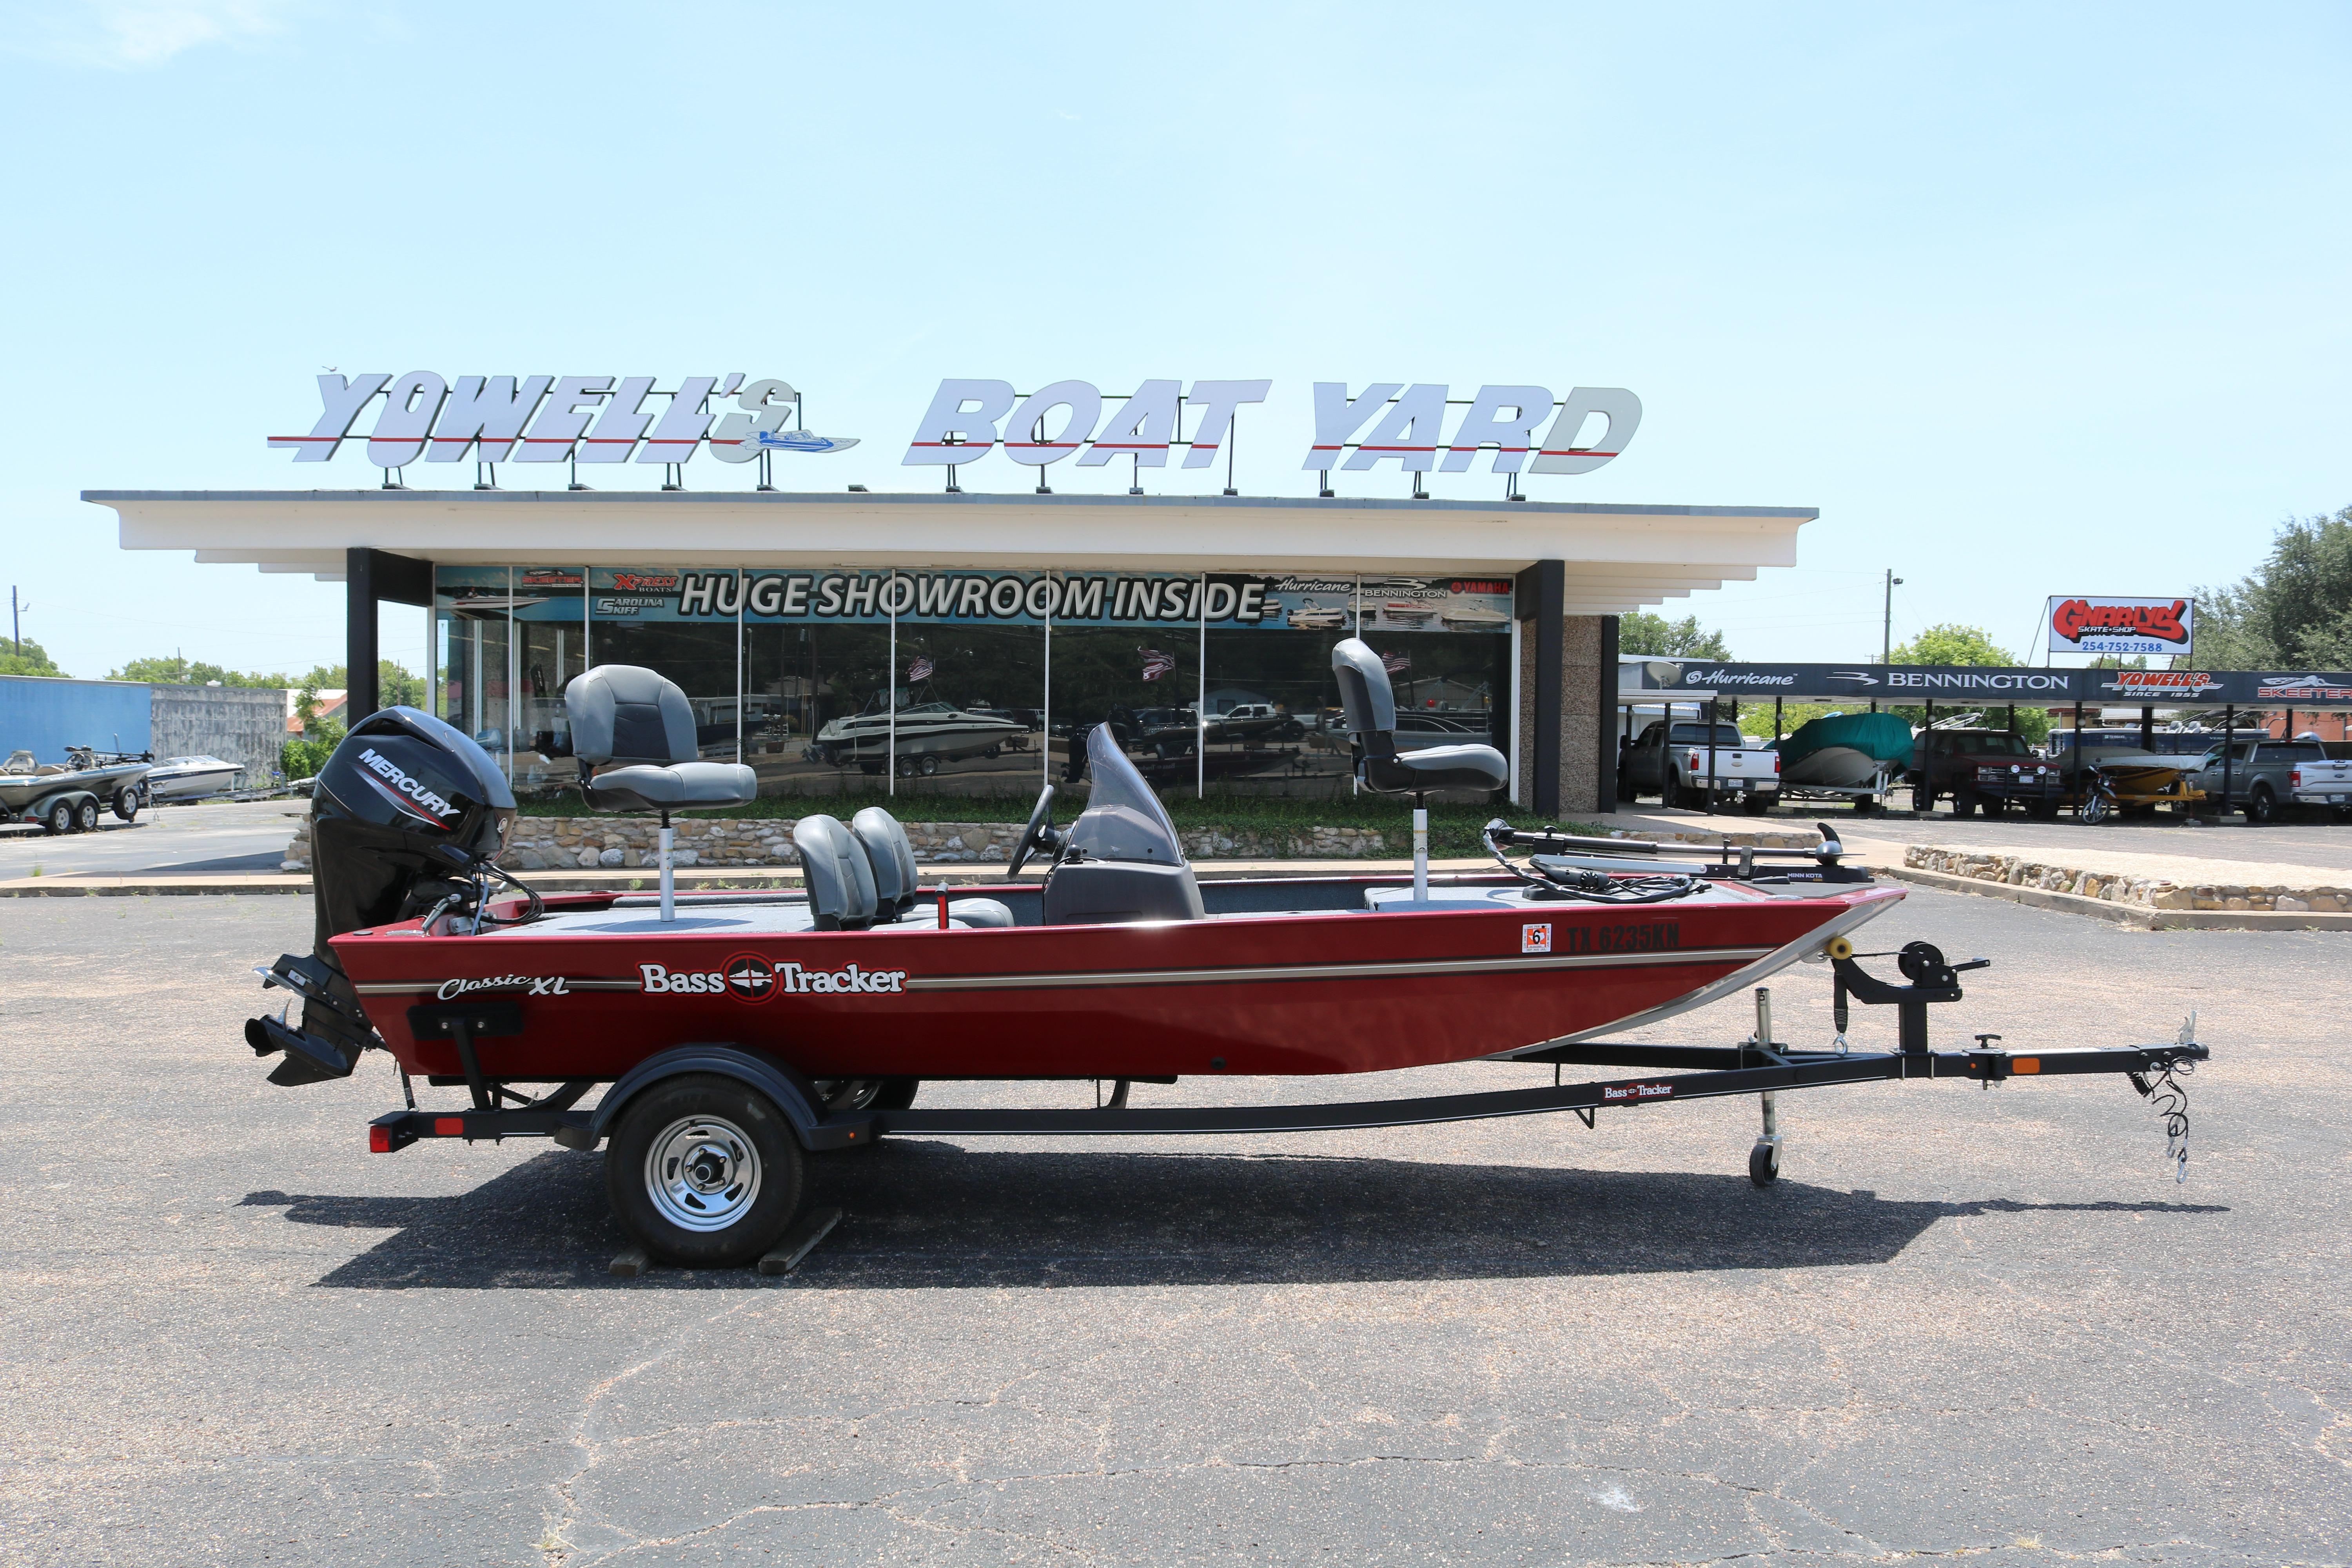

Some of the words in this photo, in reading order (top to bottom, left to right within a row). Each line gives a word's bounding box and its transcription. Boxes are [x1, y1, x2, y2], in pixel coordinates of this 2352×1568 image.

[267, 371, 796, 468] YOWELL'S
[901, 378, 1273, 469] BOAT
[1301, 381, 1643, 475] YARD
[613, 573, 678, 590] XPRESS
[1275, 577, 1351, 593] Hurricane
[1463, 582, 1510, 594] YAMAHA
[680, 576, 812, 614] HUGE
[817, 577, 1104, 618] SHOWROOM
[1112, 579, 1265, 619] INSIDE
[1365, 589, 1446, 598] BENNINGTON
[595, 601, 639, 615] SKIFF
[596, 598, 664, 608] CAROLINA
[2082, 641, 2162, 652] 254-752-7588
[1702, 670, 1794, 686] Hurricane
[1887, 672, 2069, 690] BENNINGTON
[2101, 671, 2211, 691] YOWELL'S
[2258, 687, 2352, 699] SKEETER
[358, 748, 461, 818] MERCURY
[1533, 930, 1540, 944] 6
[1566, 926, 1591, 951] TX
[1598, 922, 1679, 951] 6235KN
[639, 964, 726, 993] Bass
[775, 962, 906, 993] Tracker
[437, 974, 532, 1000] Classic
[528, 976, 570, 996] XL
[1604, 1087, 1628, 1098] Bass
[1637, 1084, 1672, 1096] Tracker
